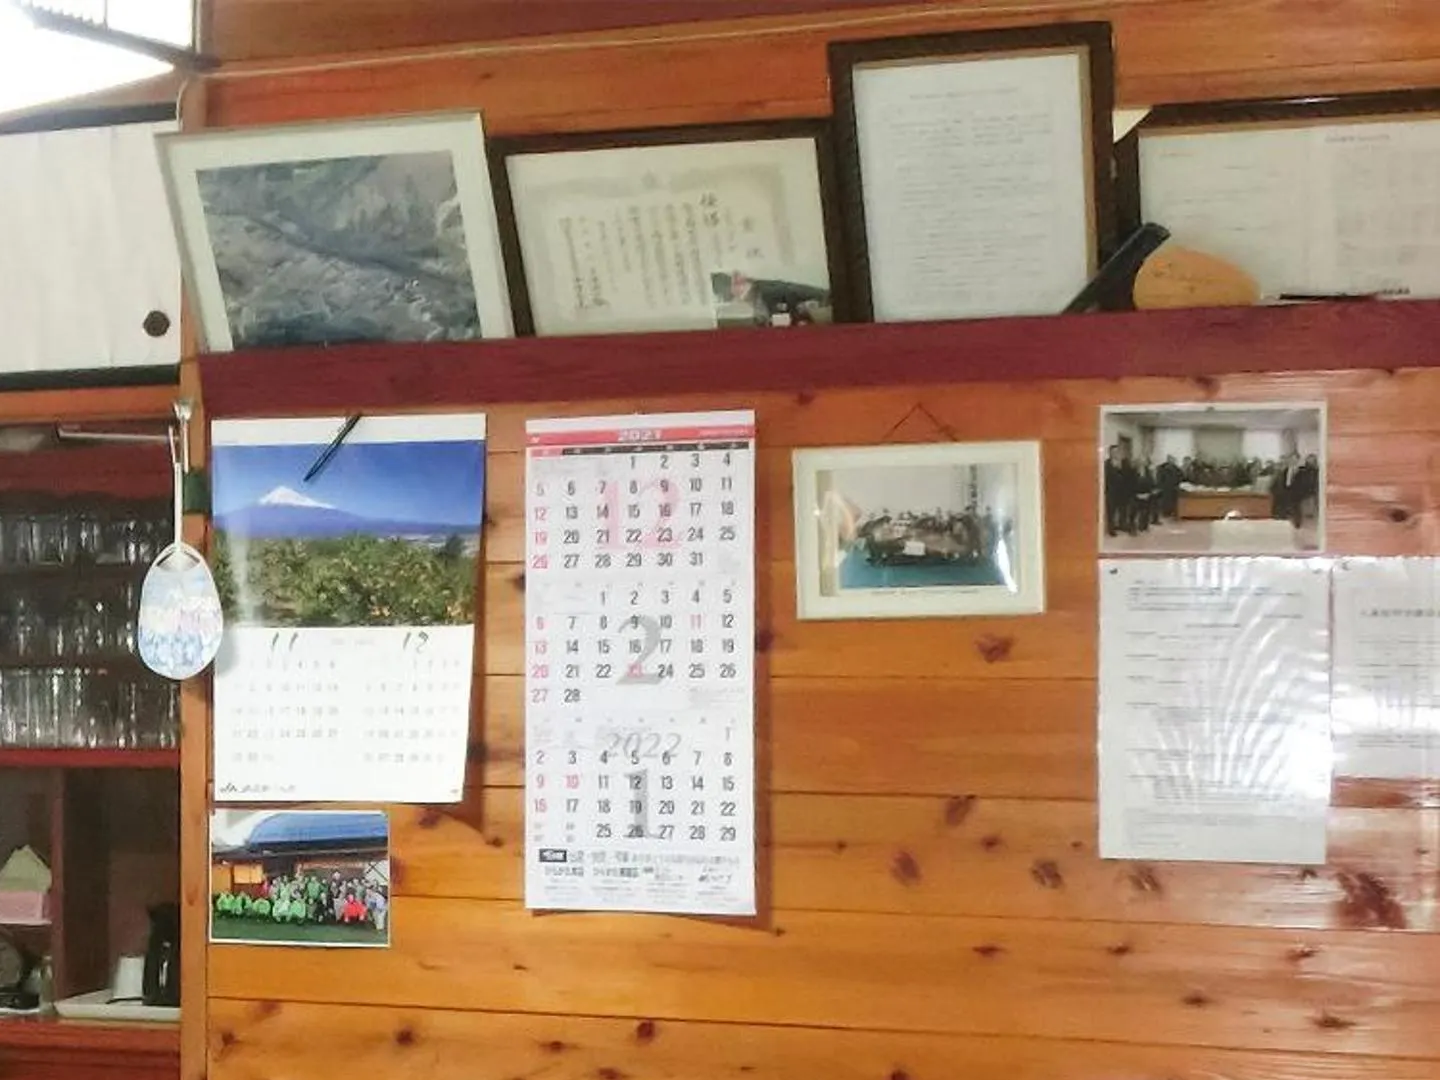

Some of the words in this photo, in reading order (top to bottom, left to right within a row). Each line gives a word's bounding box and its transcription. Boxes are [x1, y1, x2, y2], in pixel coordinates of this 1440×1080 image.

[689, 478, 702, 492] 10
[722, 477, 732, 490] 11
[534, 507, 547, 521] 12
[566, 506, 578, 519] 13
[596, 505, 609, 519] 14
[628, 504, 640, 518] 15
[659, 504, 672, 518] 16
[690, 502, 702, 516] 17
[721, 501, 734, 515] 18
[564, 530, 579, 544] 20
[597, 528, 610, 544] 21
[626, 528, 642, 543] 22
[657, 527, 673, 543] 23
[688, 527, 703, 541] 24
[719, 526, 736, 541] 25
[564, 554, 580, 568] 27
[595, 553, 611, 568] 28
[626, 552, 642, 567] 29
[658, 552, 673, 566] 30
[690, 551, 703, 566] 31
[659, 615, 673, 629] 10
[690, 614, 701, 629] 11
[722, 614, 734, 628] 12
[567, 640, 578, 653] 14
[598, 639, 610, 654] 15
[629, 639, 642, 654] 16
[659, 638, 672, 654] 17
[691, 639, 703, 653] 18
[722, 639, 734, 653] 19
[566, 664, 579, 678] 21
[596, 664, 611, 678] 22
[657, 664, 674, 678] 24
[689, 663, 705, 678] 25
[720, 663, 736, 678] 26
[531, 688, 549, 703] 27
[564, 688, 580, 703] 28
[607, 732, 682, 757] 2022
[566, 774, 580, 789] 10
[598, 774, 609, 789] 11
[629, 776, 642, 790] 12
[661, 776, 673, 790] 13
[692, 776, 704, 790] 14
[722, 776, 735, 791] 15
[566, 798, 579, 813] 17
[598, 799, 611, 813] 18
[630, 800, 643, 814] 19
[659, 800, 675, 814] 20
[691, 800, 705, 815] 21
[720, 801, 736, 816] 22
[596, 823, 612, 838] 25
[627, 824, 644, 838] 26
[659, 825, 675, 840] 27
[690, 825, 705, 840] 28
[720, 827, 736, 841] 29
